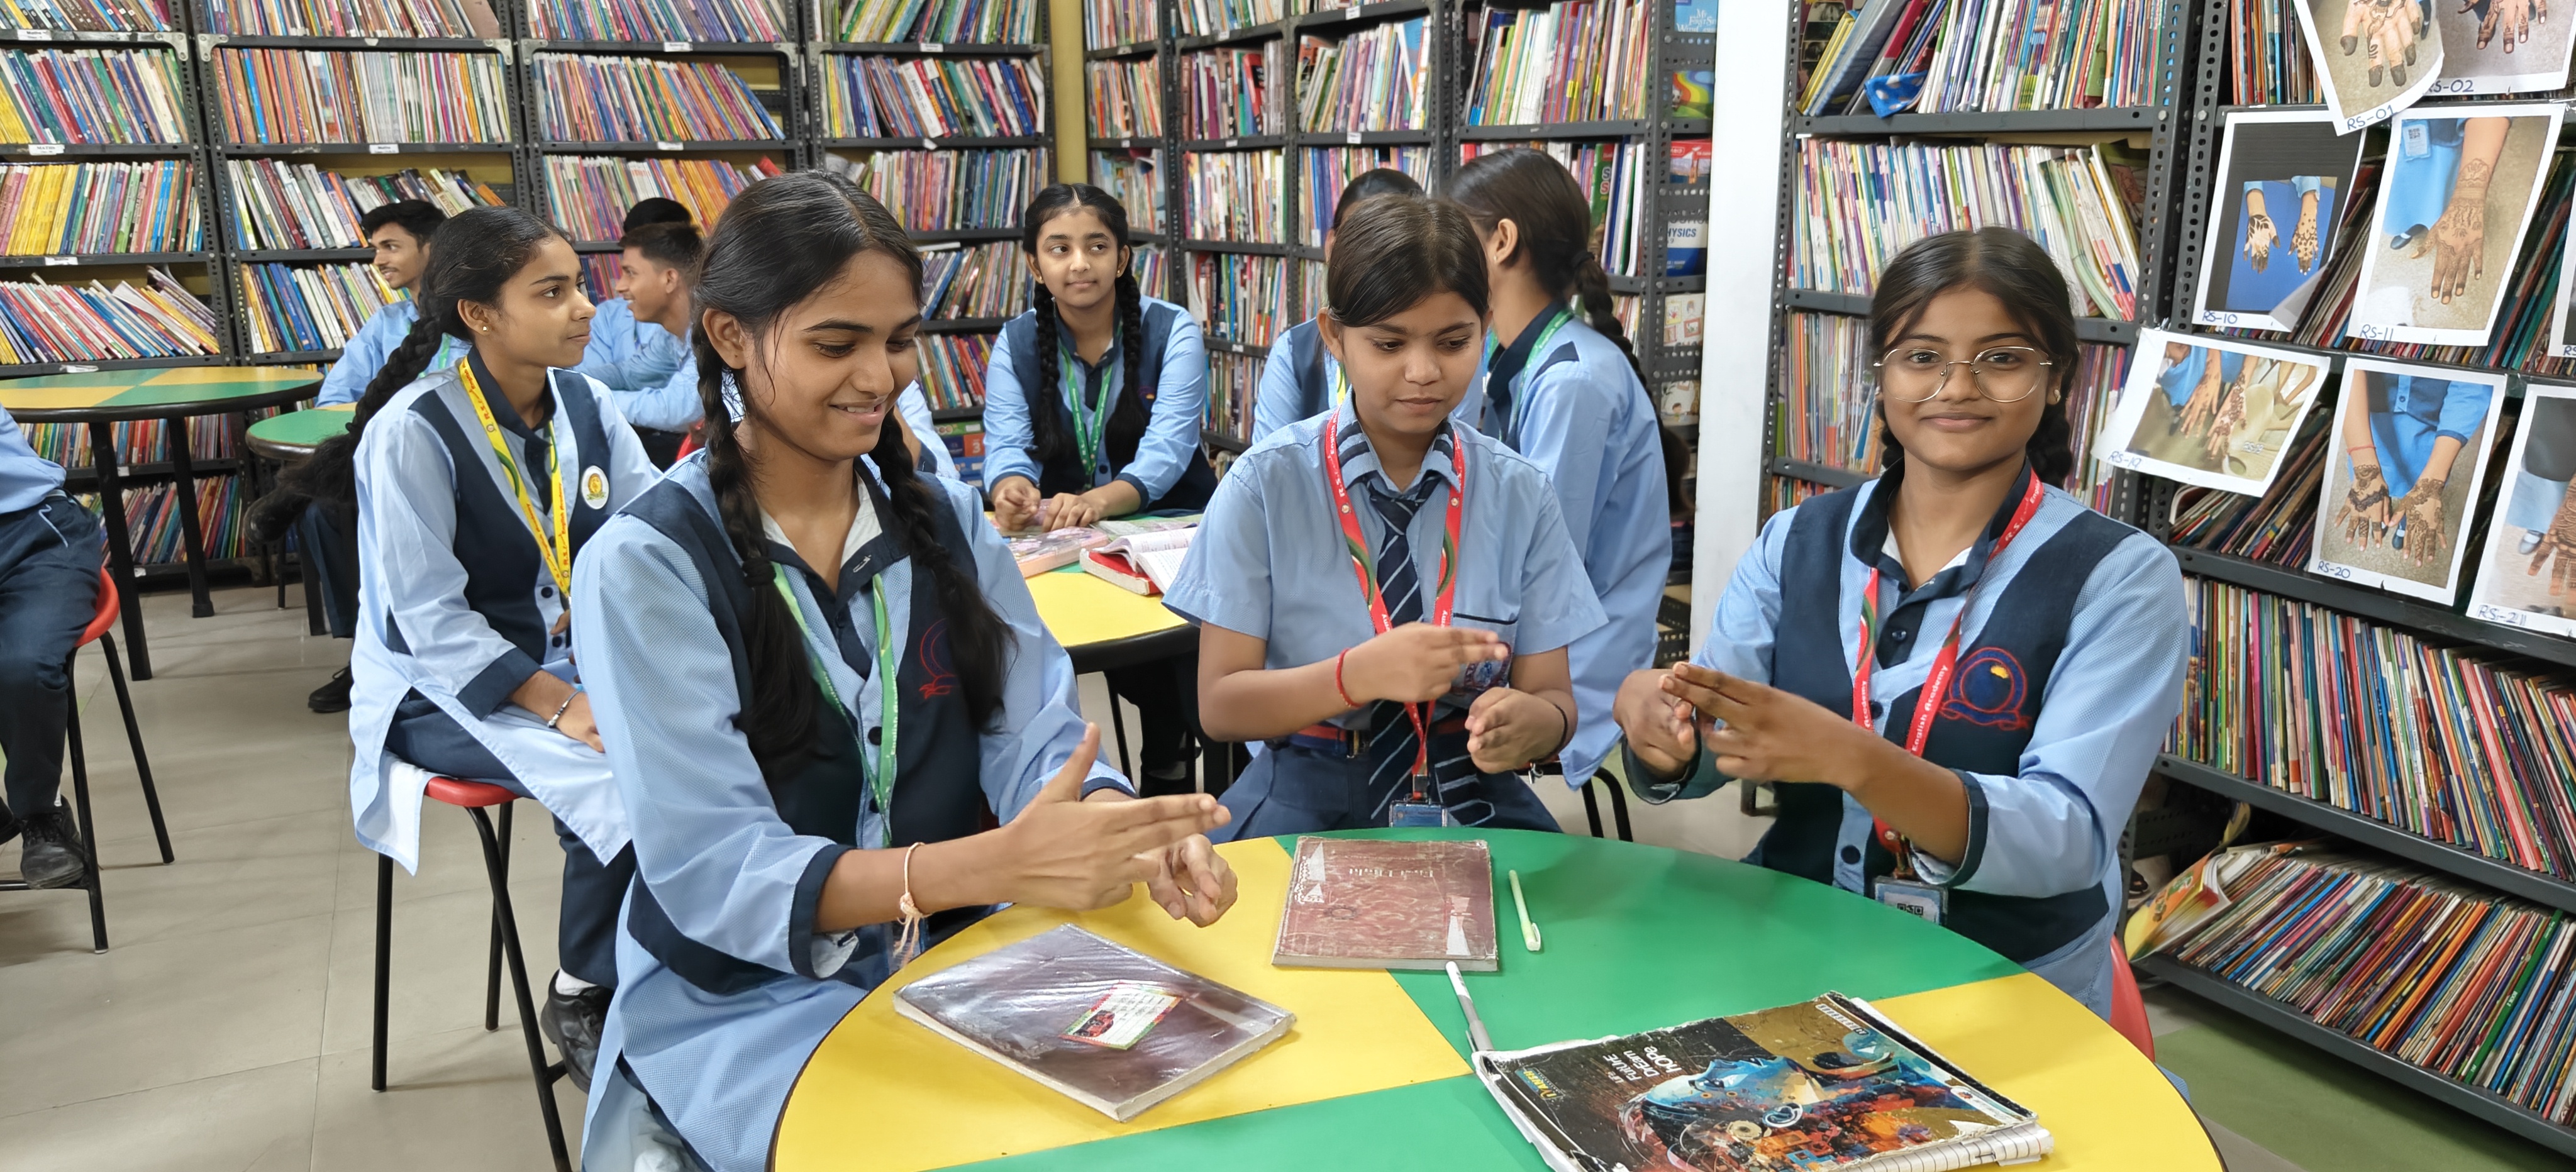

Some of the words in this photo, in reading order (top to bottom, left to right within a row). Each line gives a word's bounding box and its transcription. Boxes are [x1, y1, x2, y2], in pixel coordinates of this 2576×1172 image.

[2347, 104, 2399, 131] RS-01
[2202, 310, 2238, 324] RS-10
[2360, 324, 2394, 341] RS-11
[2317, 560, 2351, 579] RS-20
[1861, 680, 1871, 728] Academy
[1911, 714, 1928, 752] English
[1924, 665, 1949, 712] Academy
